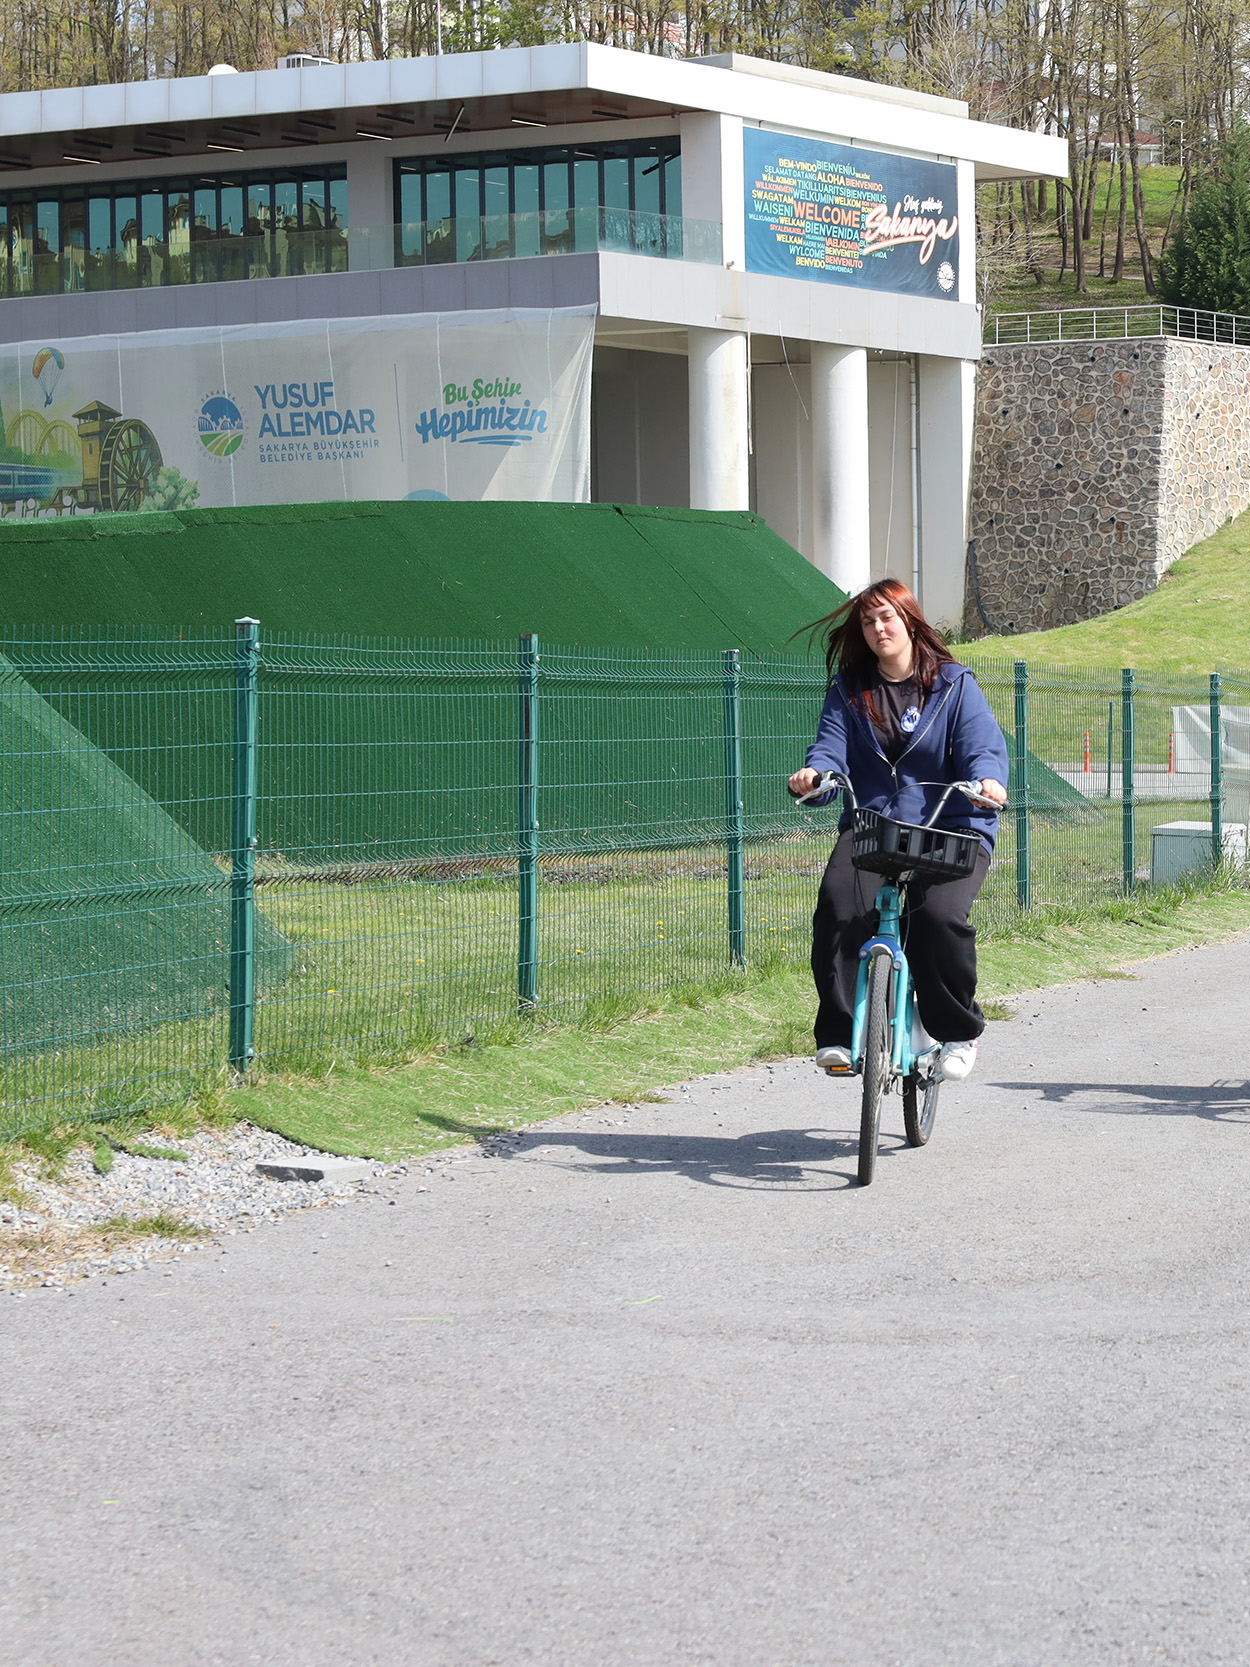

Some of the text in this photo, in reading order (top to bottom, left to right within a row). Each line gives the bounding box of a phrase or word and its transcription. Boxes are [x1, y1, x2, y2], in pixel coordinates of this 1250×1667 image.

[764, 165, 817, 180] SELAMAT DATANG
[816, 171, 846, 186] ALOHA
[755, 181, 794, 194] WILLKOMMEN
[845, 178, 883, 192] BIENVENIDO
[751, 189, 794, 204] SWAGATAM
[793, 189, 834, 205] WELKUMIN
[834, 196, 862, 209] WELKOM
[753, 200, 793, 217] WAISENI
[793, 201, 861, 228] WELCOME
[778, 216, 806, 228] WELKAM
[805, 221, 860, 241] BIENVENIDA
[864, 201, 958, 266] Sakarya
[776, 233, 804, 245] WELKAM
[789, 245, 825, 259] WYLCOME
[796, 256, 826, 269] BENVIDO
[825, 255, 864, 269] BENVENUTO
[254, 382, 334, 409] YUSUF
[443, 377, 522, 407] Bu Şehir
[258, 409, 376, 438] ALEMDAR
[415, 398, 548, 444] Hepimizin
[259, 438, 380, 453] SAKARYA BÜYÜKŞEHİR
[260, 451, 364, 463] BELEDİYE BAŞKANI
